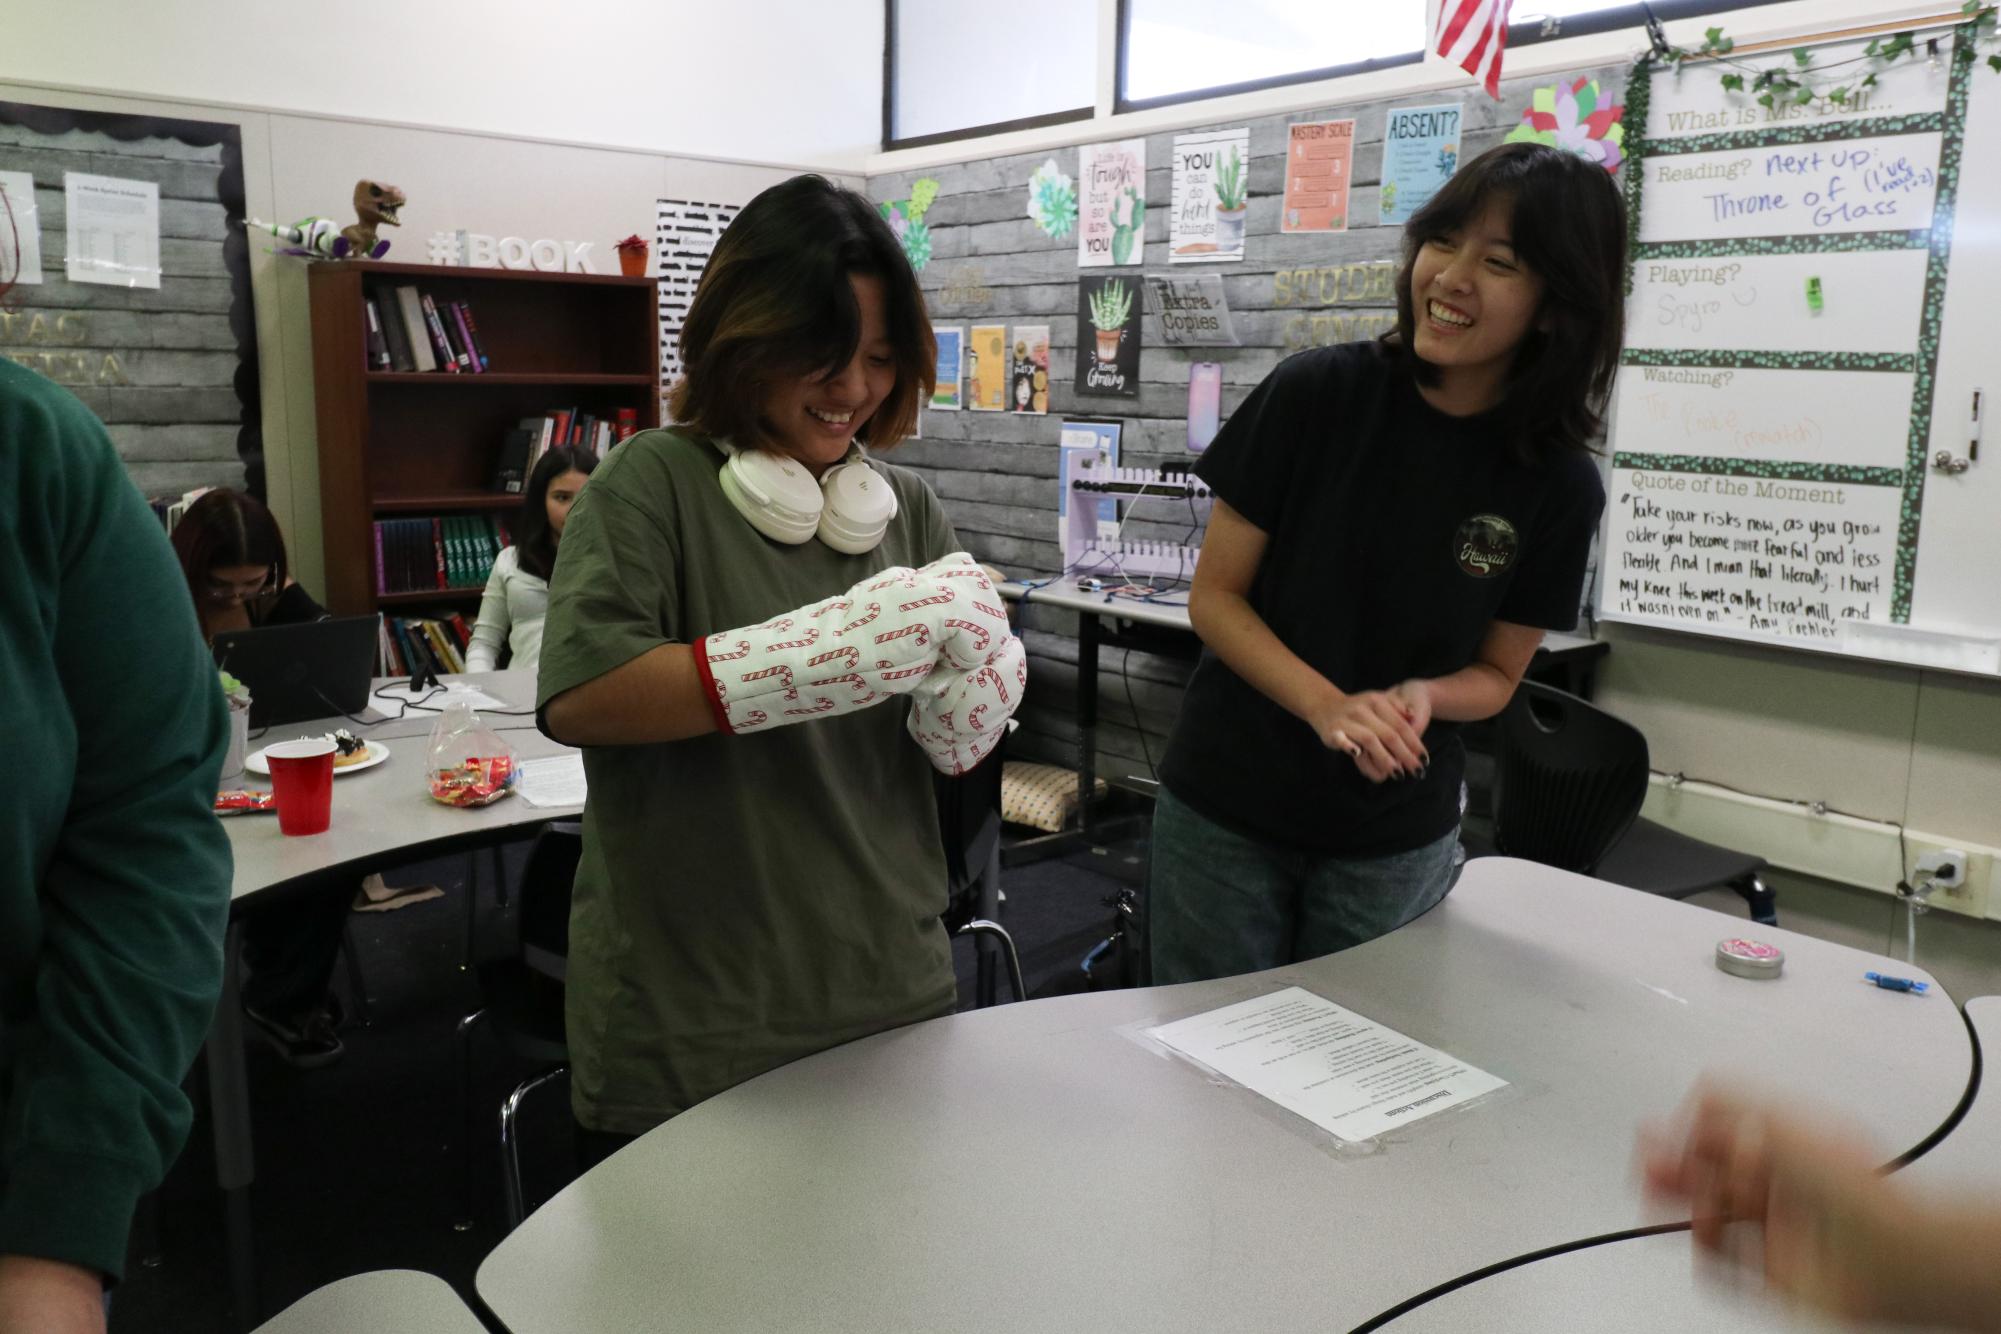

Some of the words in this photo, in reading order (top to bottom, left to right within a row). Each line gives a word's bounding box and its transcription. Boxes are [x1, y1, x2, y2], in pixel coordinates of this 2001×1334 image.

[1328, 122, 1352, 138] SCALE
[1388, 111, 1459, 140] ABSENT?
[1667, 110, 1728, 132] What
[1736, 105, 1757, 125] is
[1764, 101, 1809, 123] Ms.
[1183, 152, 1212, 171] YOU
[1657, 158, 1752, 183] Reading?
[1703, 192, 1788, 222] Throne
[1803, 175, 1846, 206] of
[1812, 199, 1897, 227] Glass
[1086, 237, 1109, 252] YOU
[1274, 263, 1397, 305] STUDE
[1648, 263, 1741, 286] Playing?
[1163, 312, 1219, 333] Copies
[1643, 368, 1734, 388] Watching?
[1631, 471, 1686, 491] Quote
[1691, 477, 1712, 493] of
[1715, 477, 1749, 496] the
[1754, 482, 1846, 505] Moment
[1666, 509, 1696, 530] your
[1703, 512, 1741, 528] risks
[1747, 519, 1779, 536] now,
[1783, 518, 1804, 531] as
[1809, 519, 1836, 543] you
[1843, 520, 1880, 544] grow
[1461, 543, 1508, 574] Hawaii
[1626, 526, 1659, 543] older
[1662, 533, 1683, 552] you
[1689, 531, 1729, 550] become
[1815, 545, 1844, 566] and
[1852, 549, 1880, 568] less
[1670, 553, 1698, 571] And
[1750, 560, 1772, 579] that
[1850, 574, 1879, 595] hurt
[1678, 605, 1702, 619] even
[1745, 588, 1761, 611] the
[1841, 601, 1869, 620] and
